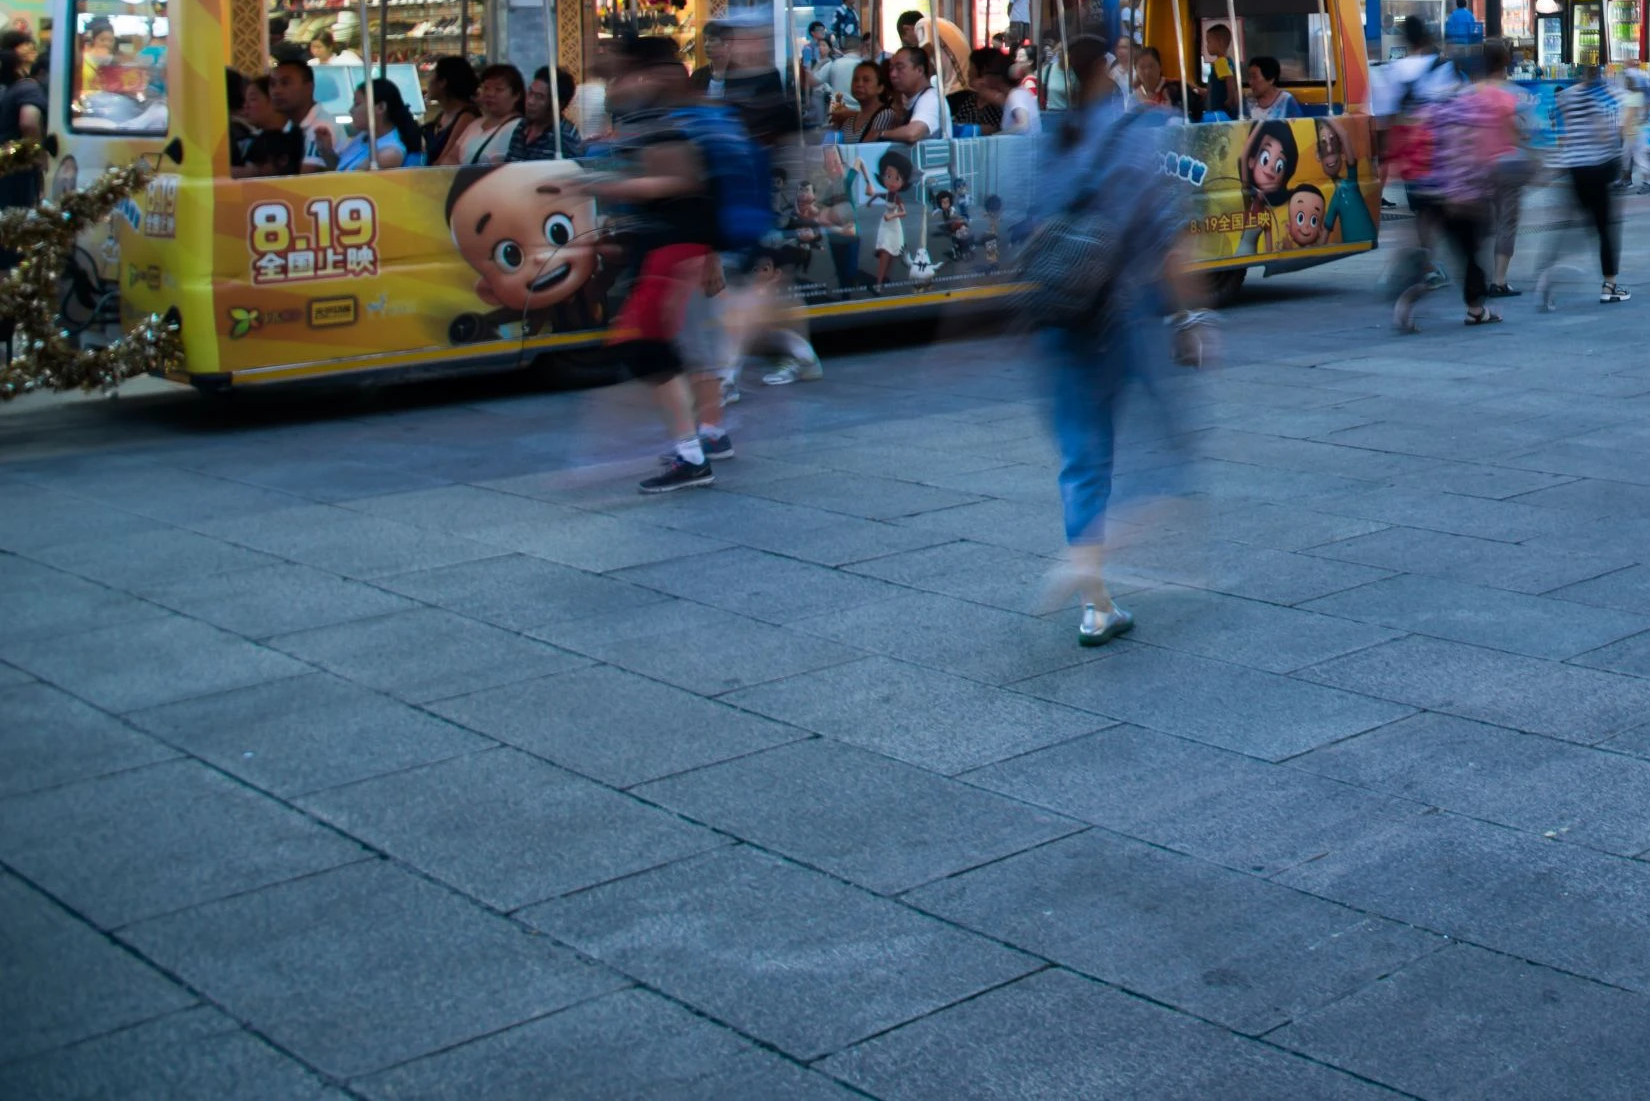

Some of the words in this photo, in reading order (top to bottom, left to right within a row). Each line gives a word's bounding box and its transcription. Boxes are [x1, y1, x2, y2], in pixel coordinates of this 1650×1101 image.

[250, 196, 376, 252] 8.19
[255, 245, 377, 284] 全国上映
